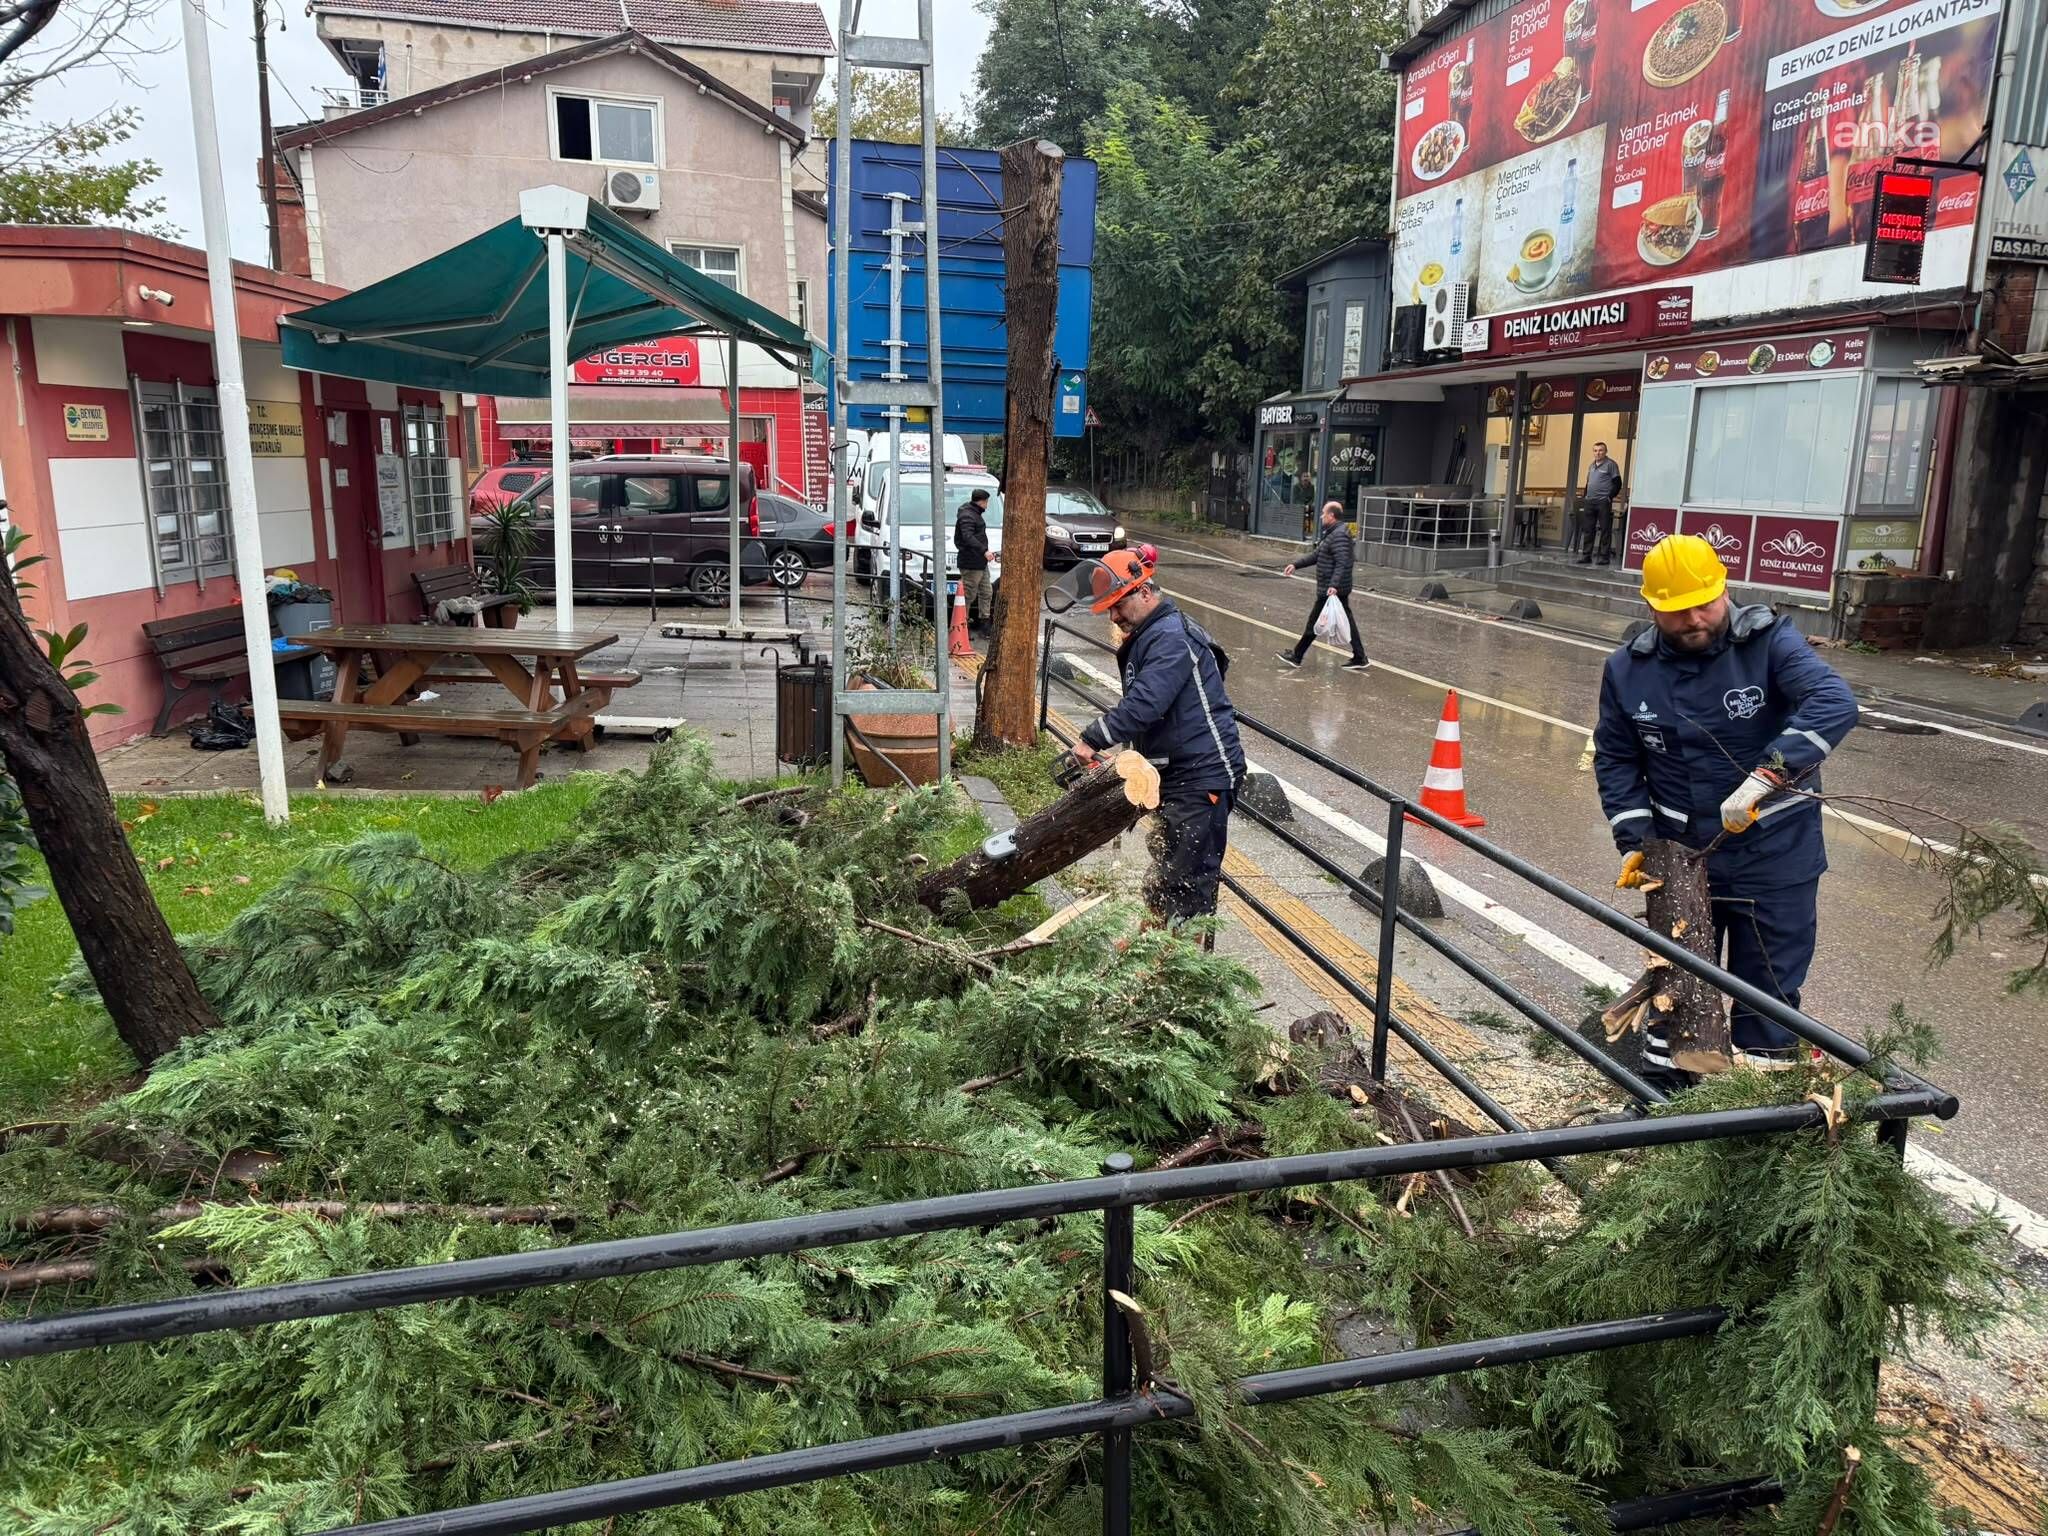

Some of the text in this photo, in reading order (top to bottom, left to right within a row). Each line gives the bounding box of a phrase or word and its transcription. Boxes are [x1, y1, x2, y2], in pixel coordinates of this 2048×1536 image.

[1510, 0, 1551, 30] Porsiyon
[1509, 14, 1551, 45] Et Döner
[1780, 46, 1836, 77] BEYKOZ
[1838, 26, 1885, 56] DENİZ
[1406, 60, 1437, 86] Arnavut
[1773, 82, 1848, 116] Coca-Cola ile
[1772, 90, 1868, 132] lezzeti tamamla!
[1619, 101, 1699, 143] Yarım Ekmek
[1617, 132, 1670, 161] Et Döner
[1497, 158, 1542, 187] Mercimek
[1614, 166, 1647, 184] Coca-Cola
[1615, 164, 1624, 173] ve
[1496, 180, 1530, 203] Çorbası
[1882, 213, 1922, 229] MEŞHUR
[1503, 301, 1626, 339] DENİZ LOKANTASI
[1658, 310, 1689, 321] DENİZ
[1548, 331, 1580, 346] BEYKOZ
[1844, 339, 1864, 349] Kelle
[1674, 361, 1692, 371] Kebap
[1719, 356, 1748, 367] Lahmacun
[1776, 352, 1805, 362] Et Döner
[1843, 351, 1863, 362] Paça
[1260, 405, 1293, 425] BAYBER
[1332, 402, 1380, 415] BAYBER
[279, 424, 302, 437] MAHALLE
[1330, 446, 1376, 466] BAYBER
[1760, 558, 1824, 573] DENİZ LOKANTASI
